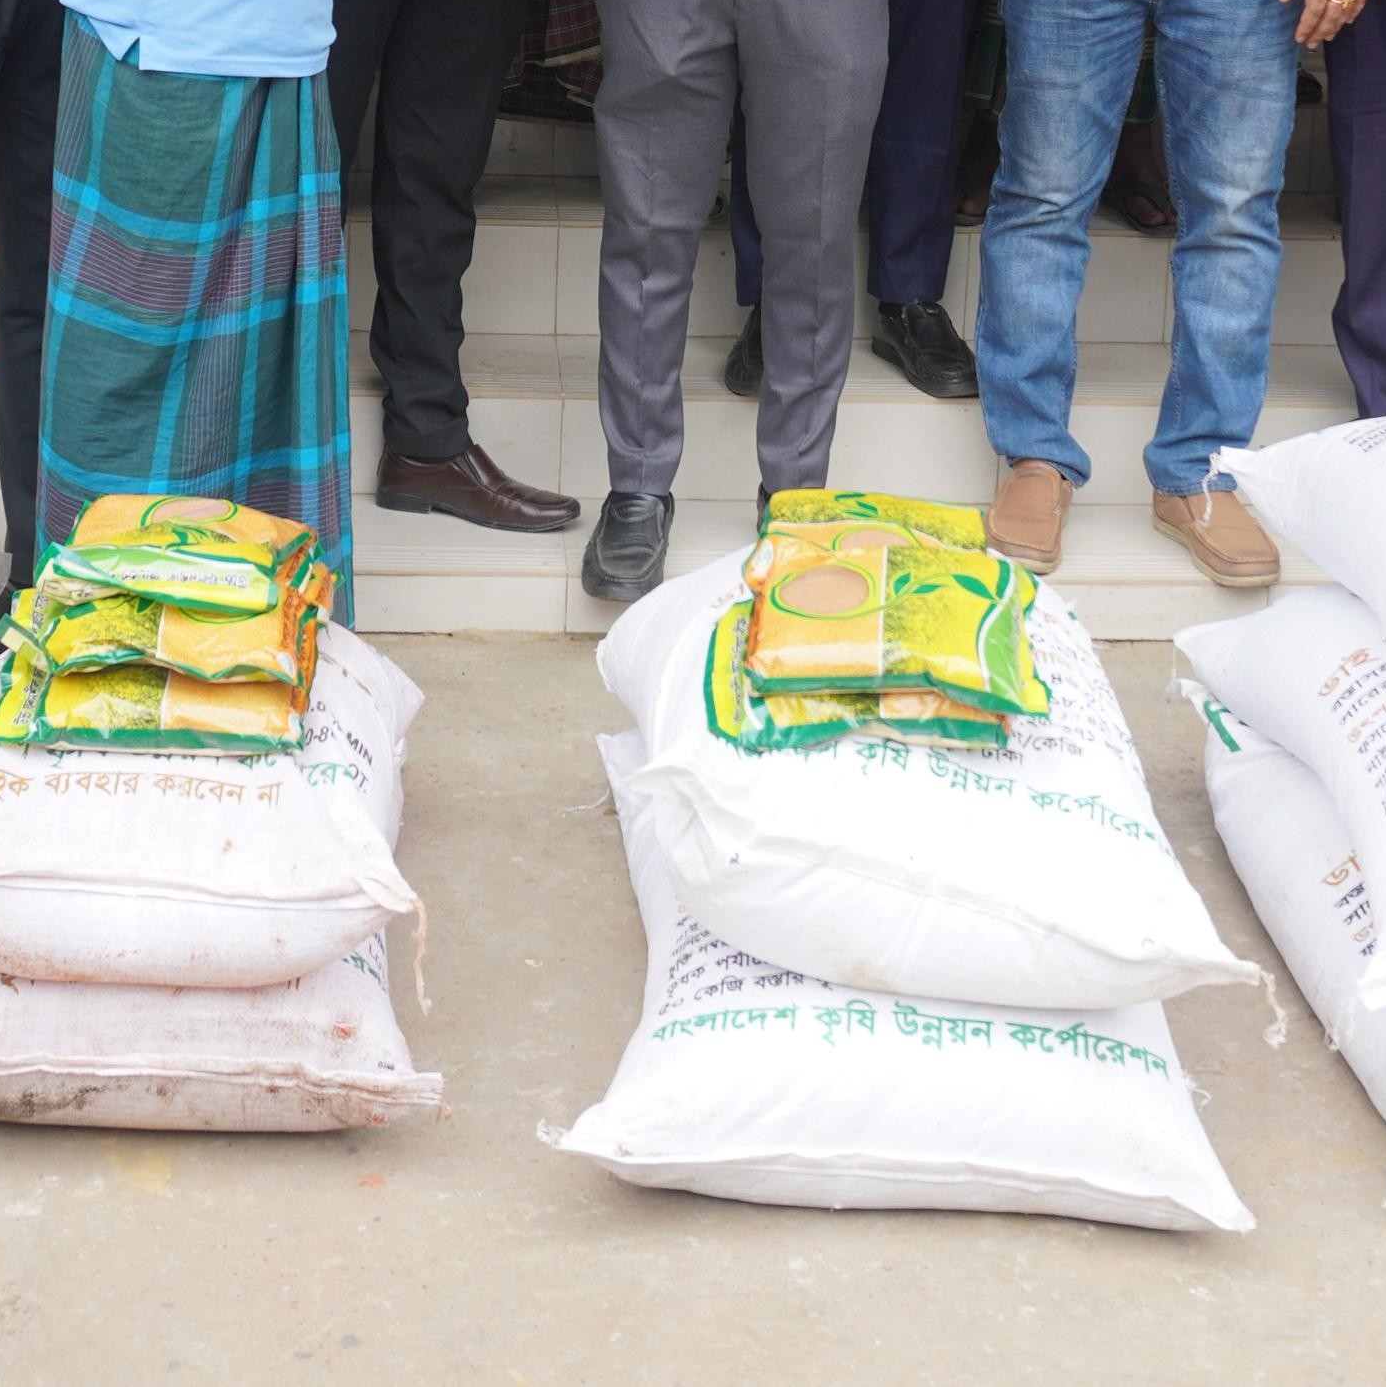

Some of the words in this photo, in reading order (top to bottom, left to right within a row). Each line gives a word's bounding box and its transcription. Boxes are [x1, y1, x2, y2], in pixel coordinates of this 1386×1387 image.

[44, 769, 141, 798] ব্যবহার
[153, 772, 247, 808] করবেন
[256, 780, 284, 810] না
[855, 736, 913, 777] কৃষি
[925, 746, 1016, 796] উন্নয়ন
[650, 1001, 799, 1043] বাংলাদেশ
[810, 998, 879, 1047] কৃষি
[890, 998, 998, 1052] উন্নয়ন
[1003, 1020, 1172, 1080] কর্পোরেশন
